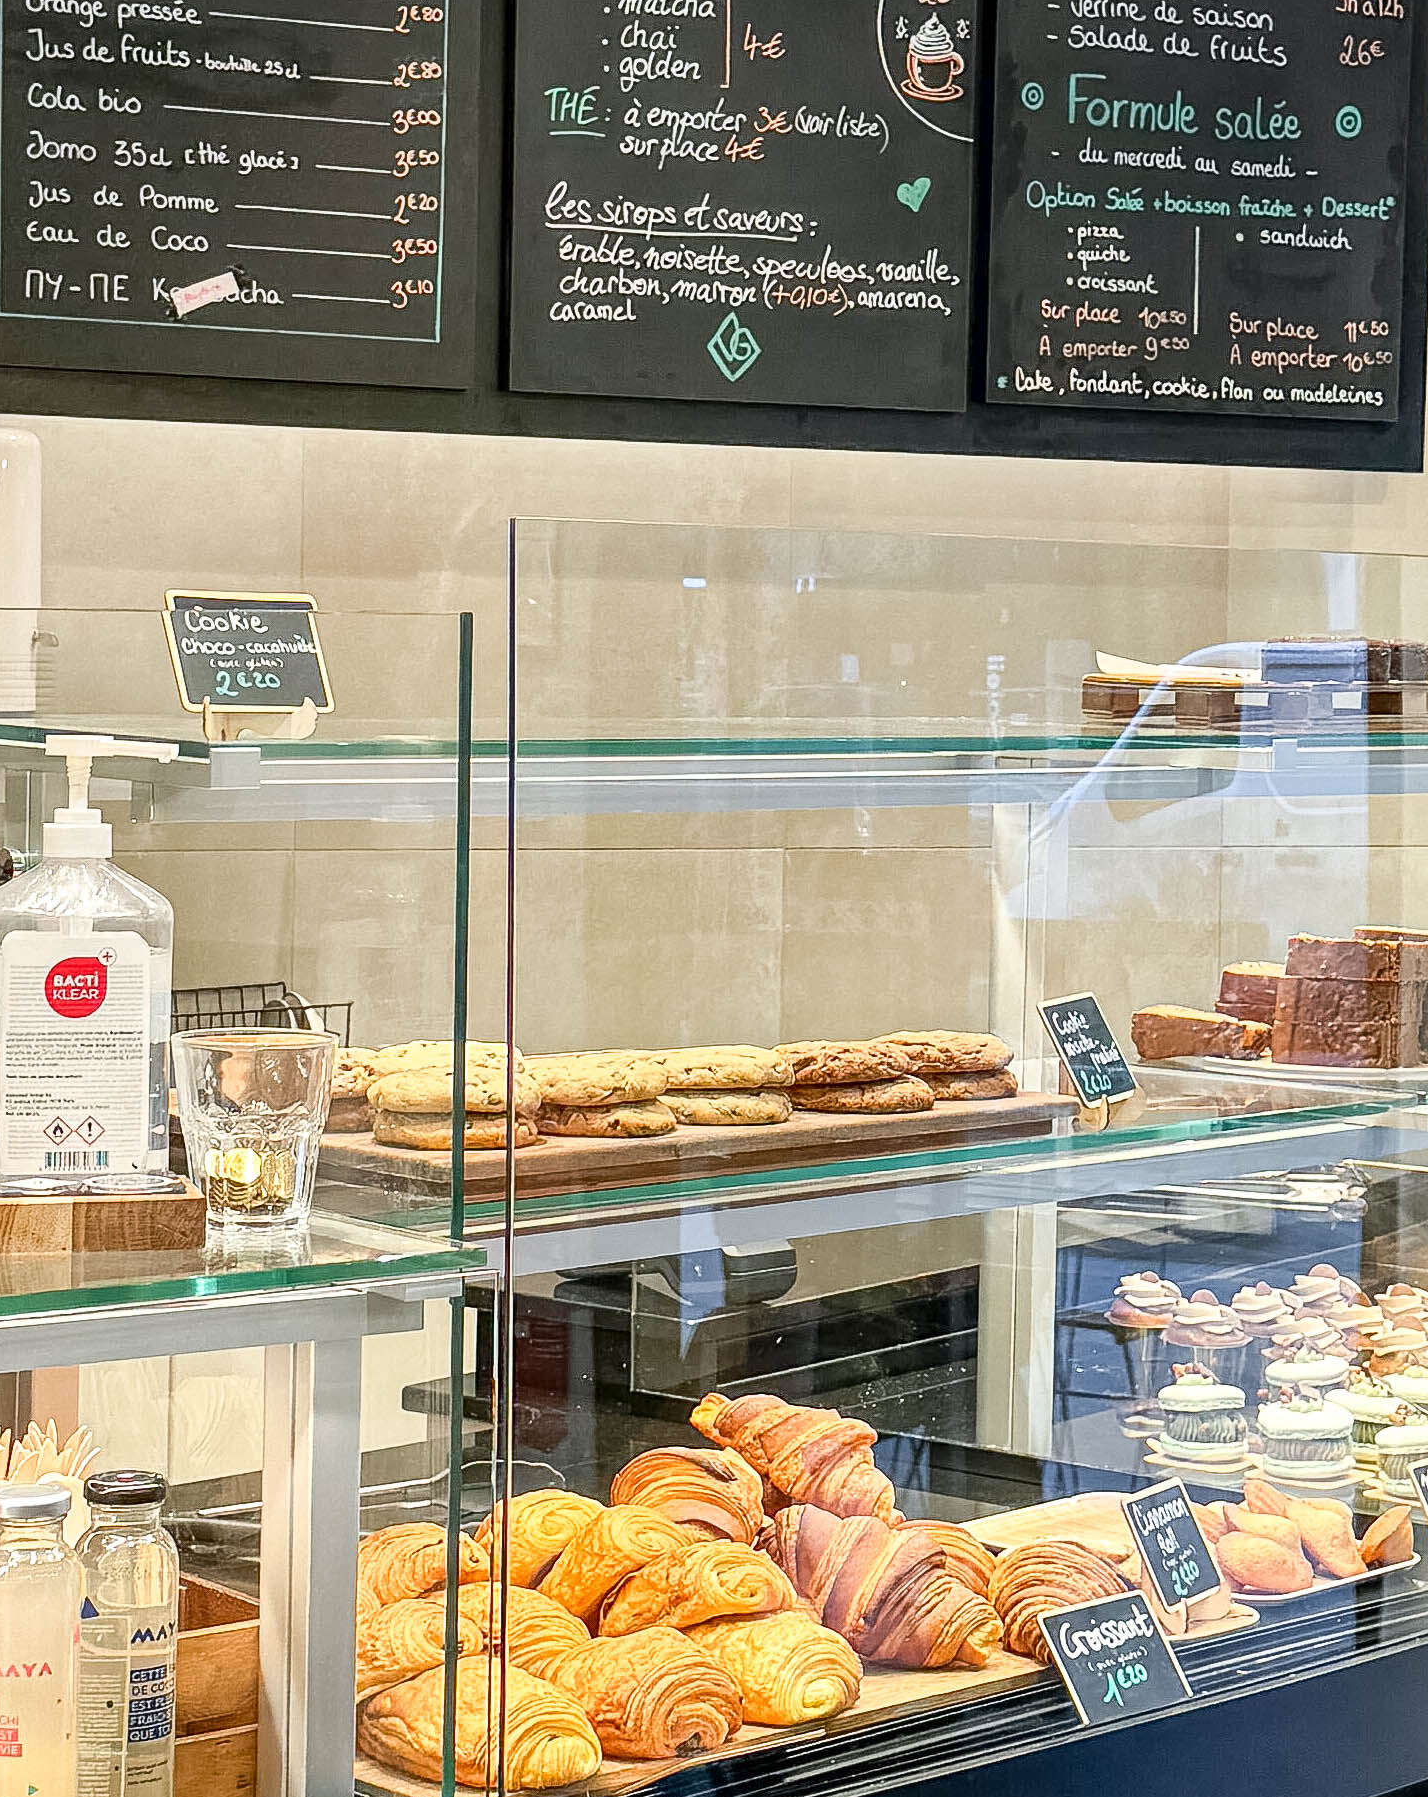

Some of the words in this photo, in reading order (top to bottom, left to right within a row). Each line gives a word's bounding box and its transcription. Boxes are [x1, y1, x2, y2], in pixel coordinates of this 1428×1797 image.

[117, 0, 202, 28] pressée
[395, 6, 443, 33] 2€80
[1068, 25, 1154, 53] Salade
[1163, 31, 1198, 56] de
[1210, 37, 1288, 67] fruits
[1339, 36, 1385, 66] 26€
[619, 53, 701, 92] golden
[28, 83, 86, 111] Cola
[98, 85, 142, 113] bio
[1068, 73, 1199, 133] Formule
[1215, 96, 1302, 140] salée
[619, 136, 656, 155] sur
[659, 136, 719, 169] place
[724, 140, 766, 163] 4€
[1079, 137, 1108, 163] du
[1114, 147, 1186, 171] mercredi
[1195, 156, 1218, 174] au
[1231, 148, 1295, 178] samedi
[29, 180, 71, 207] Jus
[93, 184, 123, 206] de
[139, 186, 219, 213] Pomme
[393, 194, 438, 223] 2€20
[26, 224, 80, 243] Eau
[96, 226, 131, 248] de
[151, 225, 209, 251] Coco
[391, 237, 437, 264] 3€50
[1077, 223, 1124, 246] pizza
[1260, 225, 1352, 251] sandwich
[1077, 248, 1131, 273] quiche
[1077, 276, 1158, 295] croissant
[549, 300, 637, 322] caramel
[184, 606, 268, 633] Cookie
[53, 988, 98, 1000] KLEAR
[1059, 1604, 1153, 1660] Croissant
[132, 1685, 148, 1696] DE
[132, 1700, 152, 1712] EST
[1, 1745, 20, 1754] VIE
[130, 1729, 155, 1741] QUE
